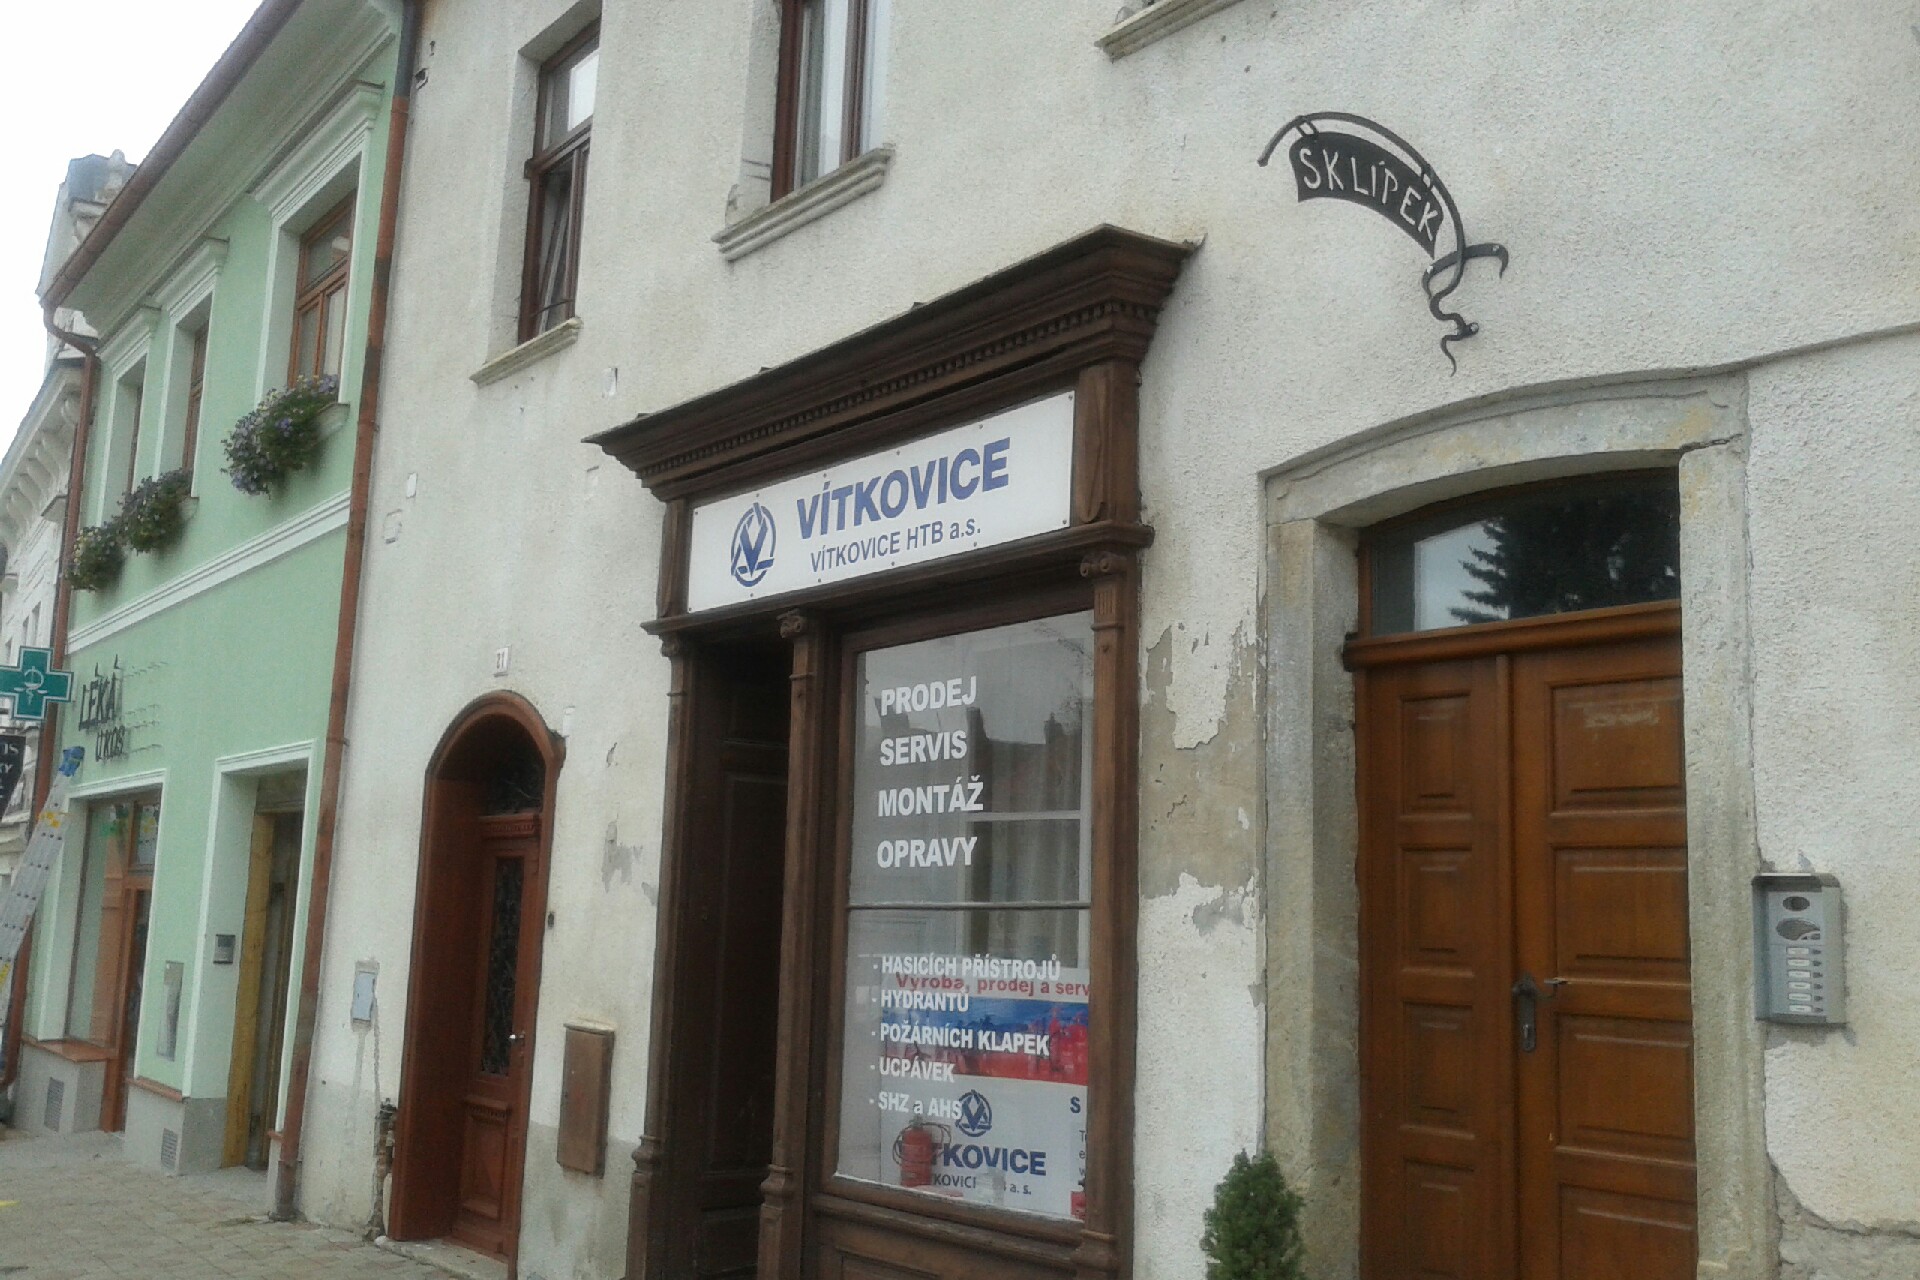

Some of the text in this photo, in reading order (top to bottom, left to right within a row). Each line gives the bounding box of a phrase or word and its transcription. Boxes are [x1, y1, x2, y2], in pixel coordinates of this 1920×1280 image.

[1299, 147, 1438, 241] SKLÍPEK
[797, 437, 1010, 539] VÍTKOVICE
[811, 518, 981, 572] VÍTKOVICE HTB a.s.
[880, 676, 977, 716] PRODEJ
[880, 730, 968, 766] SERVIS
[878, 775, 984, 817] MONTÁŽ
[877, 837, 978, 868] OPRAVY
[881, 952, 1061, 981] HASICÍCH PŘÍSTROJŮ
[880, 986, 969, 1013] HYDRANTŮ
[977, 978, 1035, 997] prodej
[1040, 982, 1050, 994] a
[880, 1019, 1050, 1057] POŽÁRNÍCH KLAPEK
[879, 1056, 956, 1083] UCPÁVEK
[878, 1091, 963, 1120] SHZ a AHS
